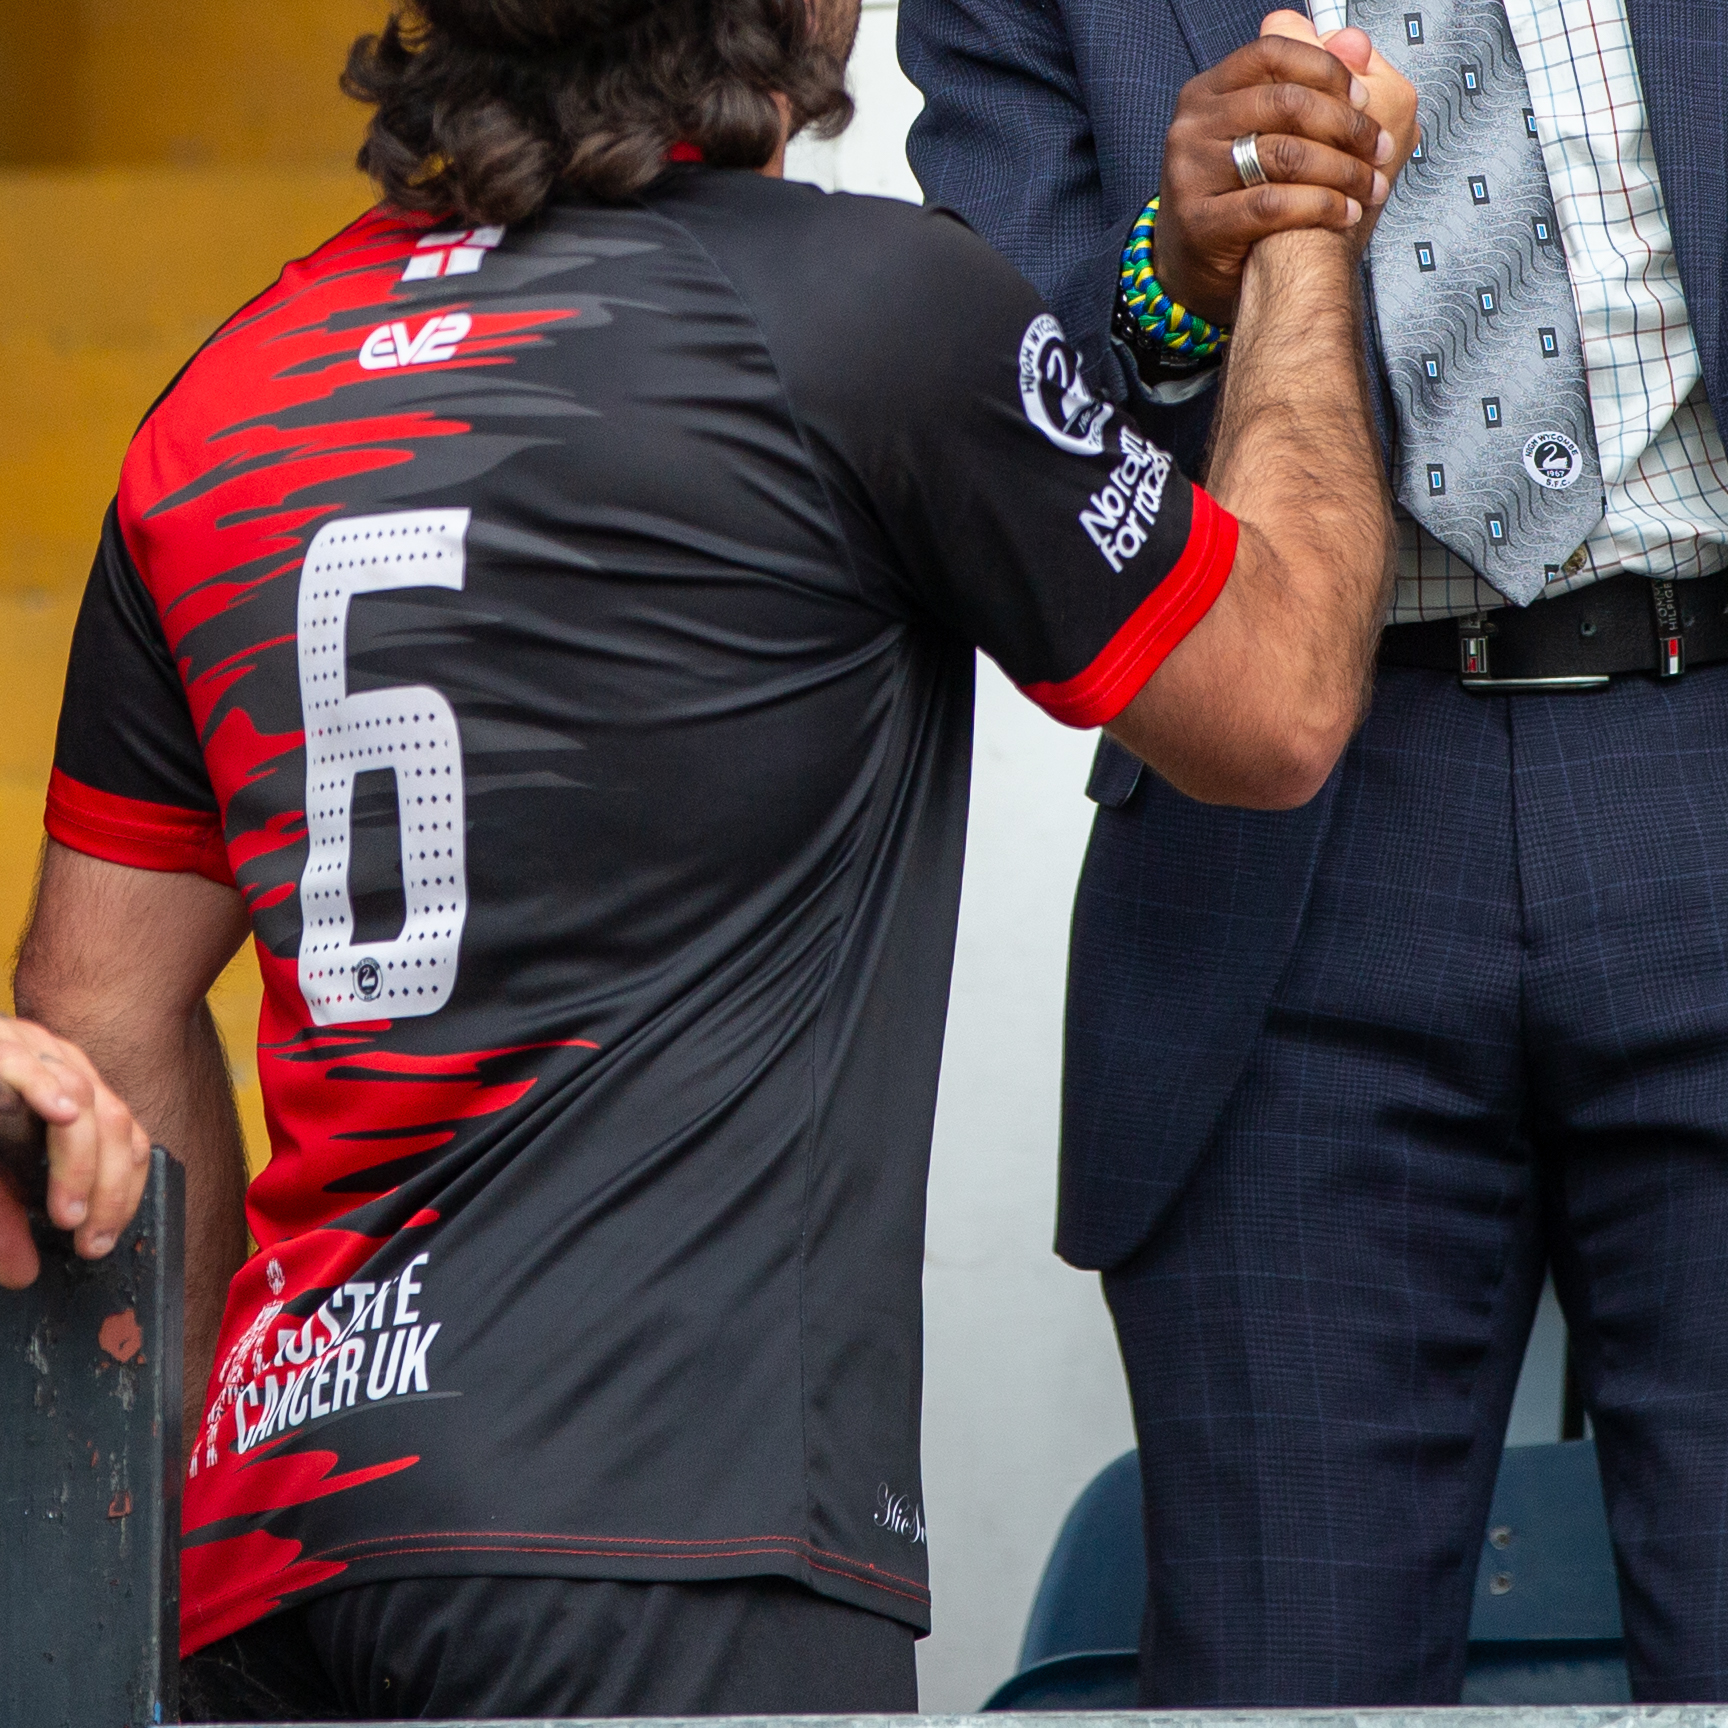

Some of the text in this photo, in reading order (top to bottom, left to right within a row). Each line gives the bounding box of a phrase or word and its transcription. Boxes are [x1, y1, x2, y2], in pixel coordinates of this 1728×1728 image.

[358, 312, 473, 371] EV2
[1537, 433, 1579, 456] WYCOMBE
[1078, 484, 1125, 546] No
[297, 508, 471, 1027] 6
[365, 1322, 442, 1401] UK
